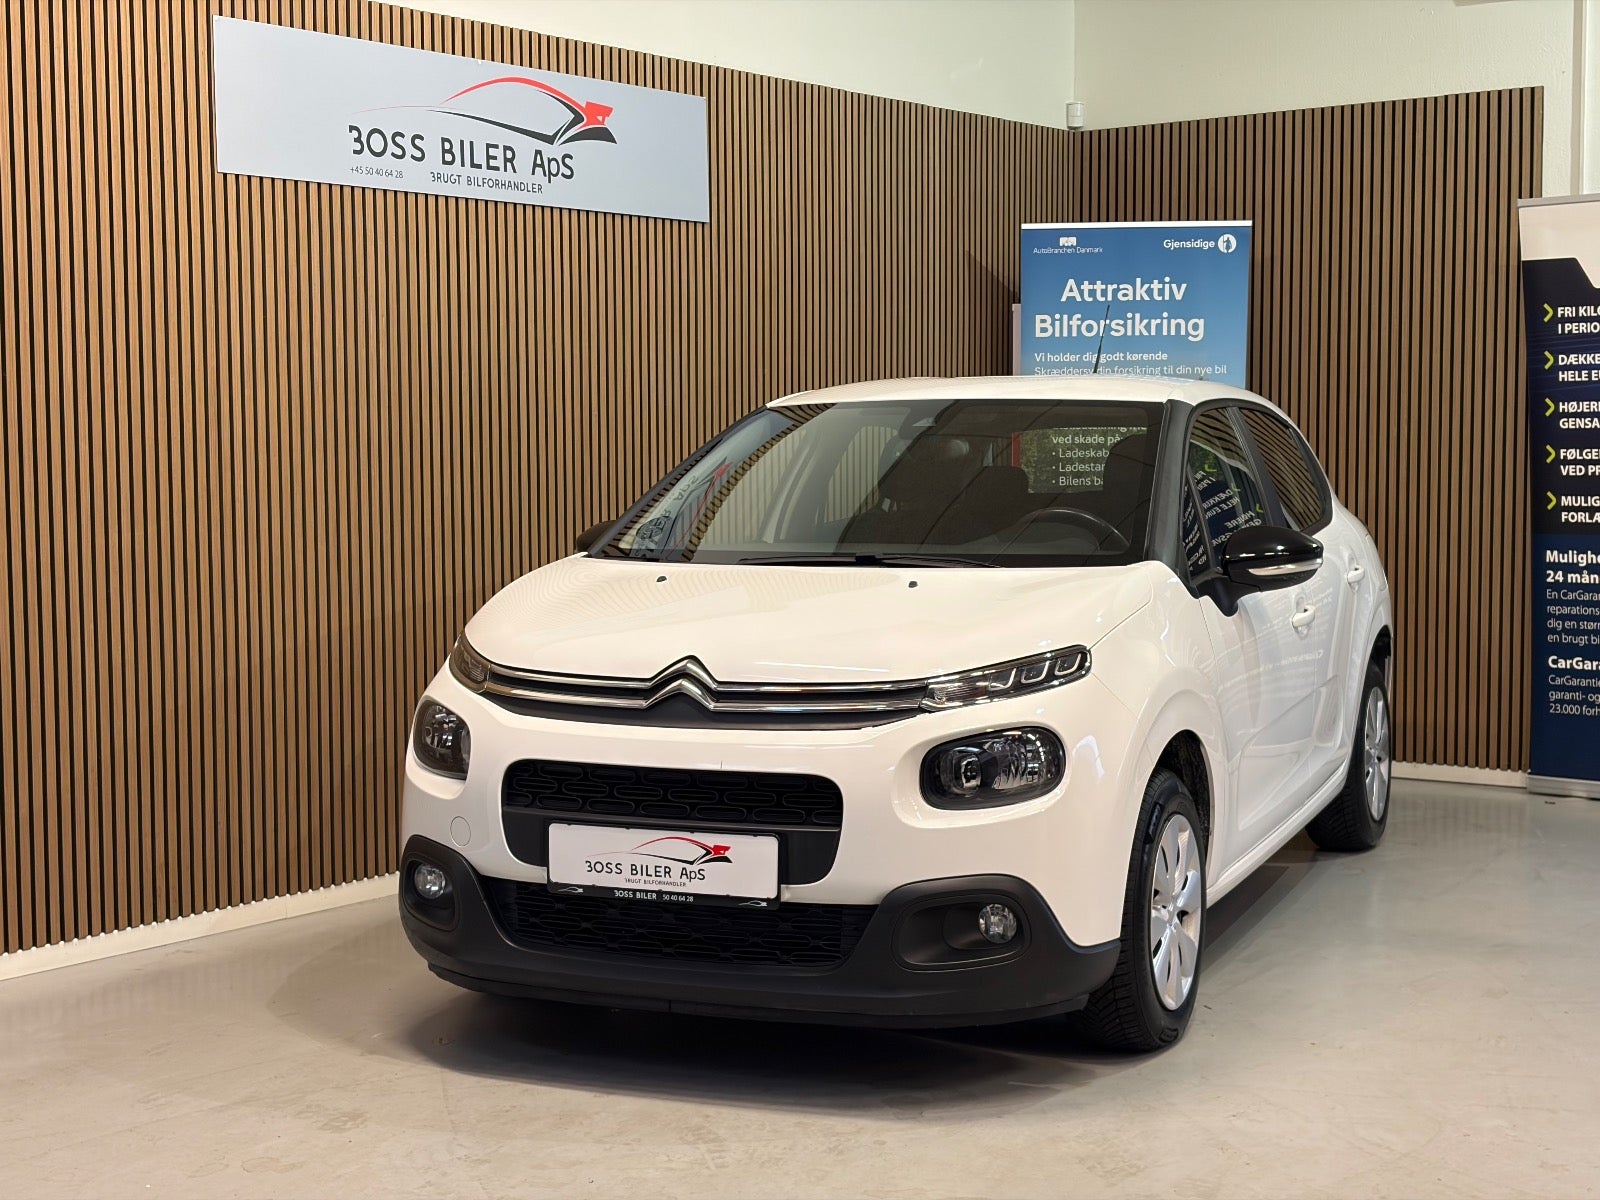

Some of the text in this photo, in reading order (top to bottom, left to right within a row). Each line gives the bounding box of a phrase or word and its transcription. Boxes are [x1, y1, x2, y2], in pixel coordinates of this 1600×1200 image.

[441, 136, 517, 174] BILER
[531, 149, 575, 184] ApS
[350, 166, 403, 179] +45 50 40 64 28
[467, 175, 543, 194] BILFORHANDLER
[1077, 246, 1103, 254] Danmark
[1163, 239, 1215, 250] Gjensidige
[1061, 277, 1187, 302] Attraktiv
[1558, 306, 1576, 318] FRI
[1035, 312, 1205, 342] Bilforsikring
[1558, 322, 1600, 334] I PERIO
[1034, 352, 1168, 364] Vi holder dig godt kørende
[1114, 365, 1161, 376] forsikring
[1163, 365, 1174, 374] til
[1176, 365, 1192, 374] din
[1194, 367, 1212, 377] nye
[1214, 365, 1227, 374] bil
[1559, 370, 1589, 382] HELE
[1559, 401, 1600, 413] HØJER
[1052, 435, 1071, 444] ved
[1074, 435, 1105, 444] skade
[1059, 448, 1110, 458] Ladeskab
[1560, 448, 1600, 460] FØLGE
[1560, 465, 1585, 476] VED
[1059, 476, 1091, 486] Bilens
[1546, 570, 1600, 584] 24 mån
[1546, 589, 1558, 599] En
[1547, 618, 1562, 630] dig
[1565, 621, 1577, 629] en
[1547, 634, 1559, 643] en
[1562, 633, 1588, 646] brugt
[1548, 655, 1600, 670] CarGar
[1549, 691, 1600, 704] garanti- og
[1549, 703, 1580, 715] 23.000
[630, 863, 672, 878] BILER
[680, 867, 706, 882] ApS
[636, 891, 657, 900] BILER
